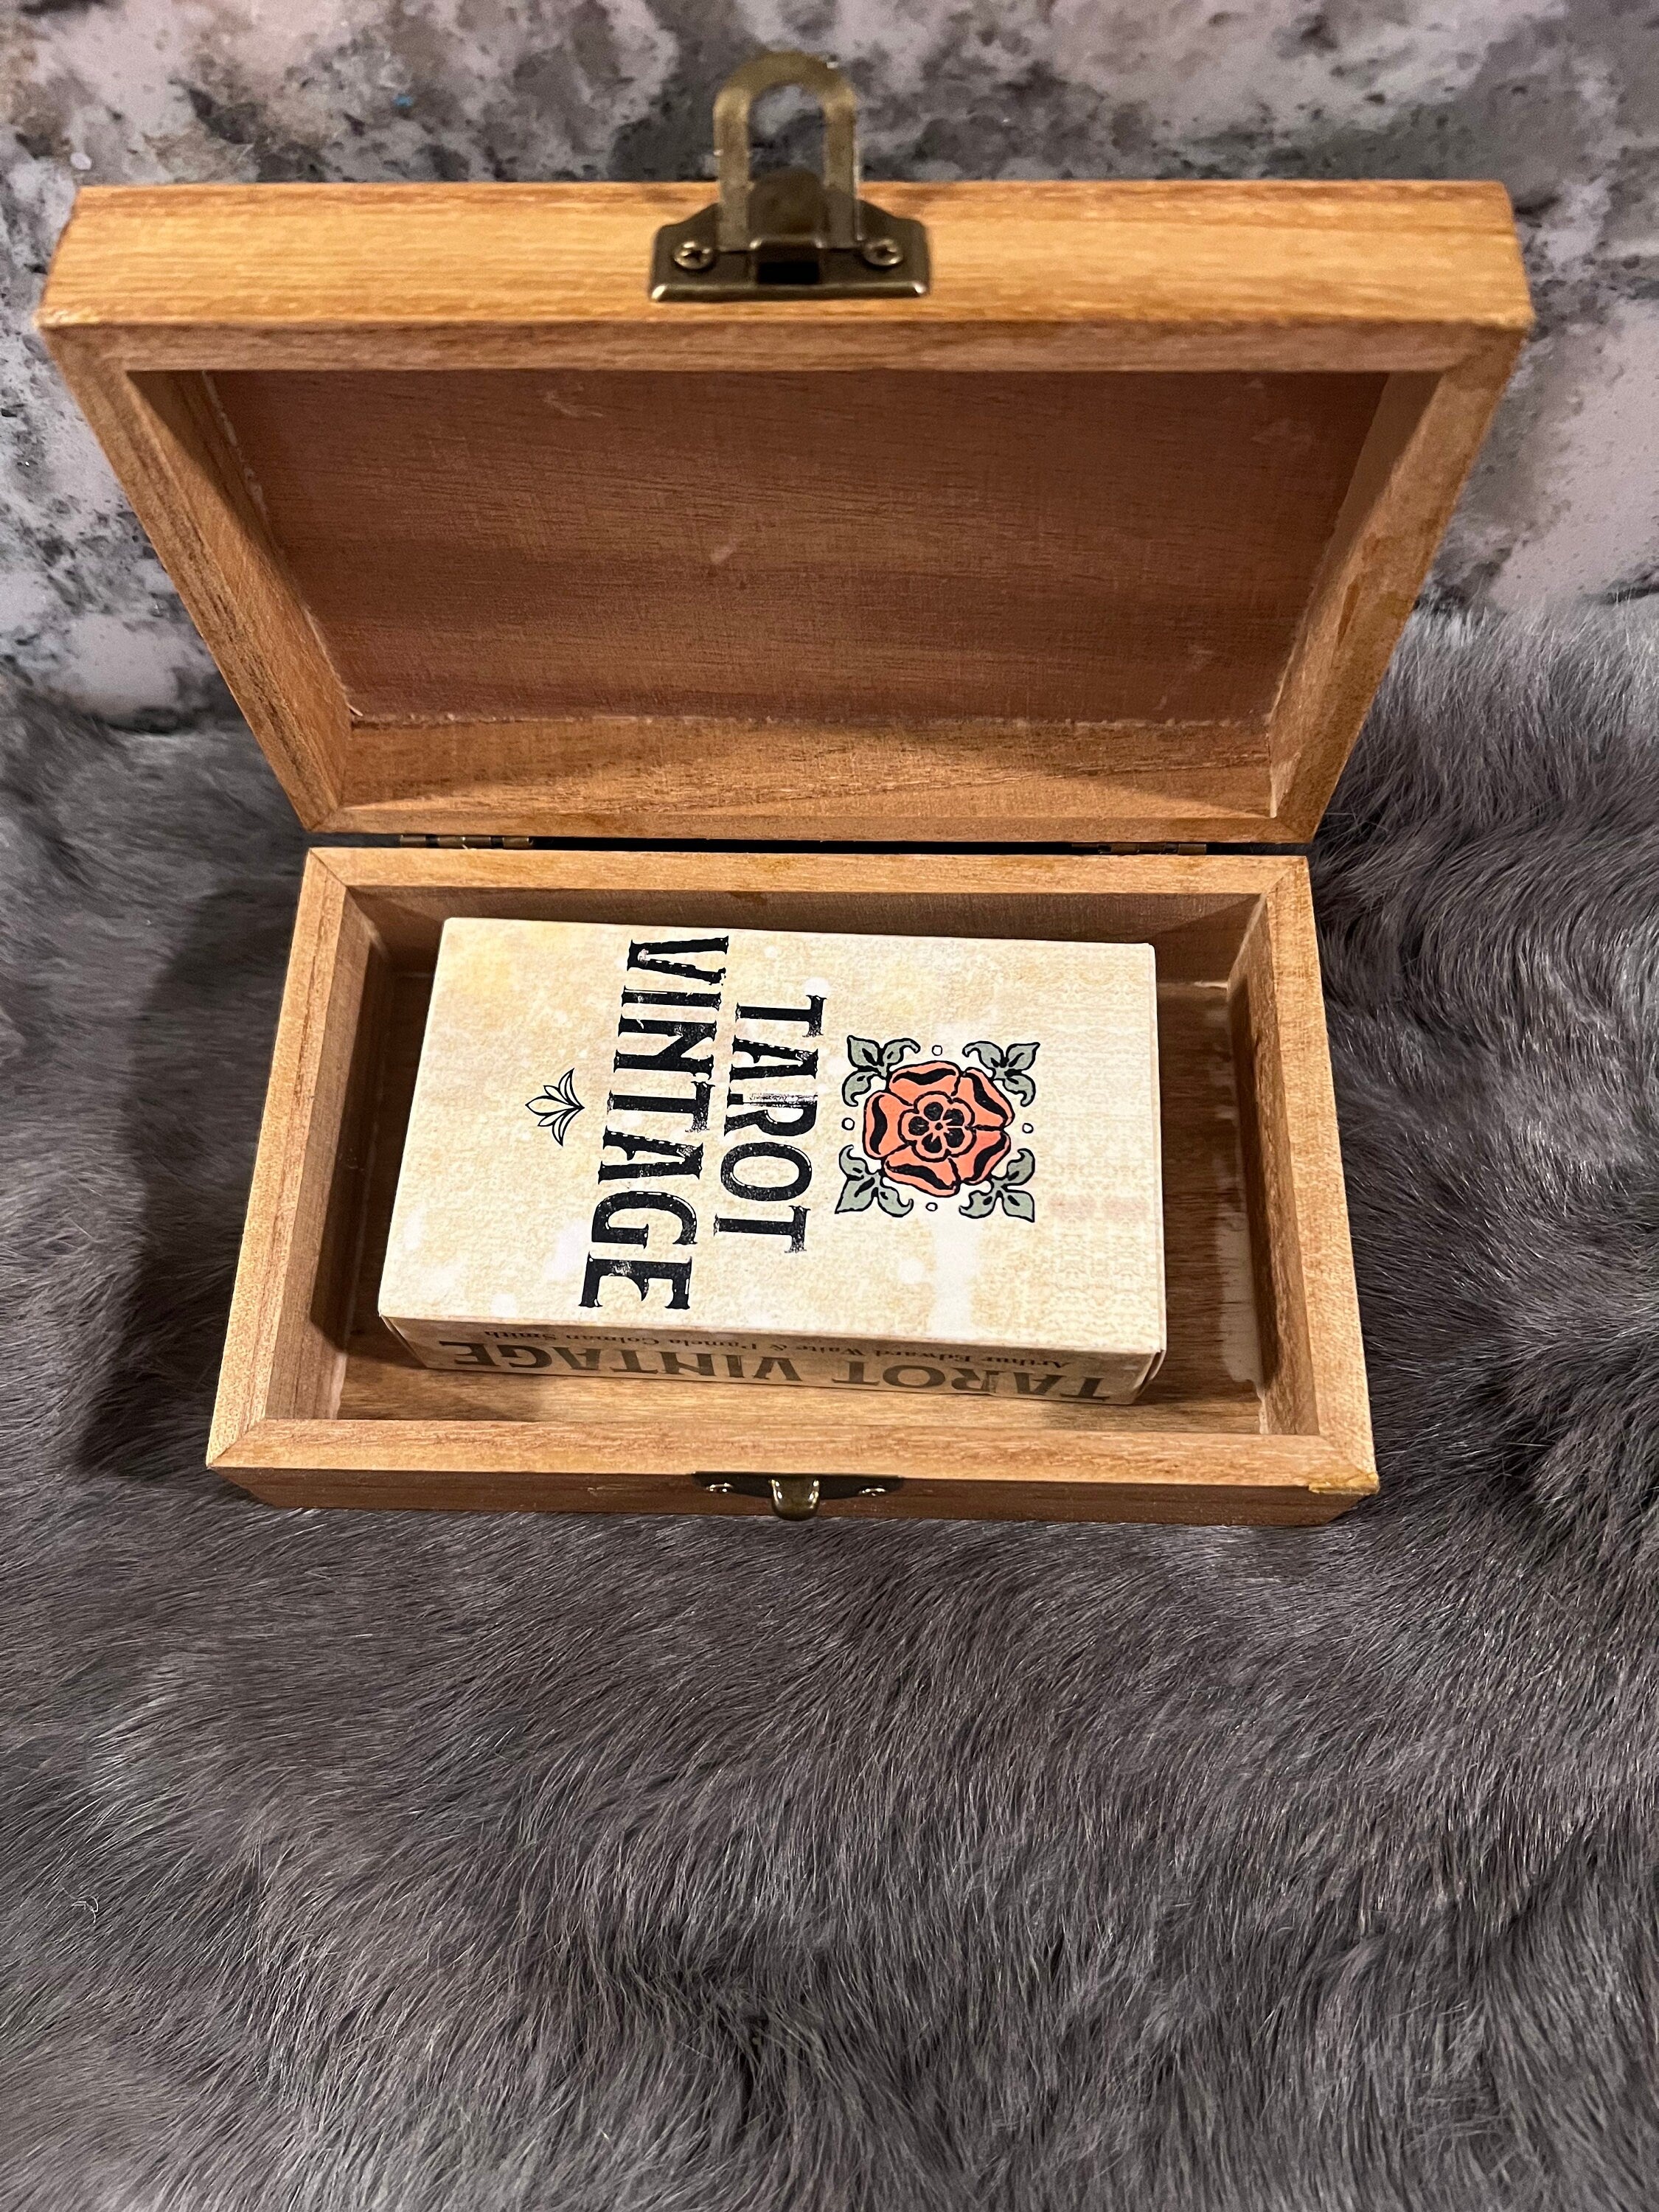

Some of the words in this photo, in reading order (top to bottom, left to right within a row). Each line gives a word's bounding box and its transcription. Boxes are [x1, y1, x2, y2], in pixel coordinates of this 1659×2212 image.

[578, 935, 729, 1310] VINTAGE
[714, 995, 827, 1253] TAROT
[483, 1330, 557, 1340] Smith
[566, 1334, 660, 1346] Colman
[669, 1338, 757, 1351] Pamela
[795, 1344, 867, 1356] Waite
[438, 1340, 803, 1381] VINTAGE
[874, 1349, 973, 1363] Edward
[981, 1354, 1072, 1368] Arthur
[831, 1360, 1110, 1401] TAROT
